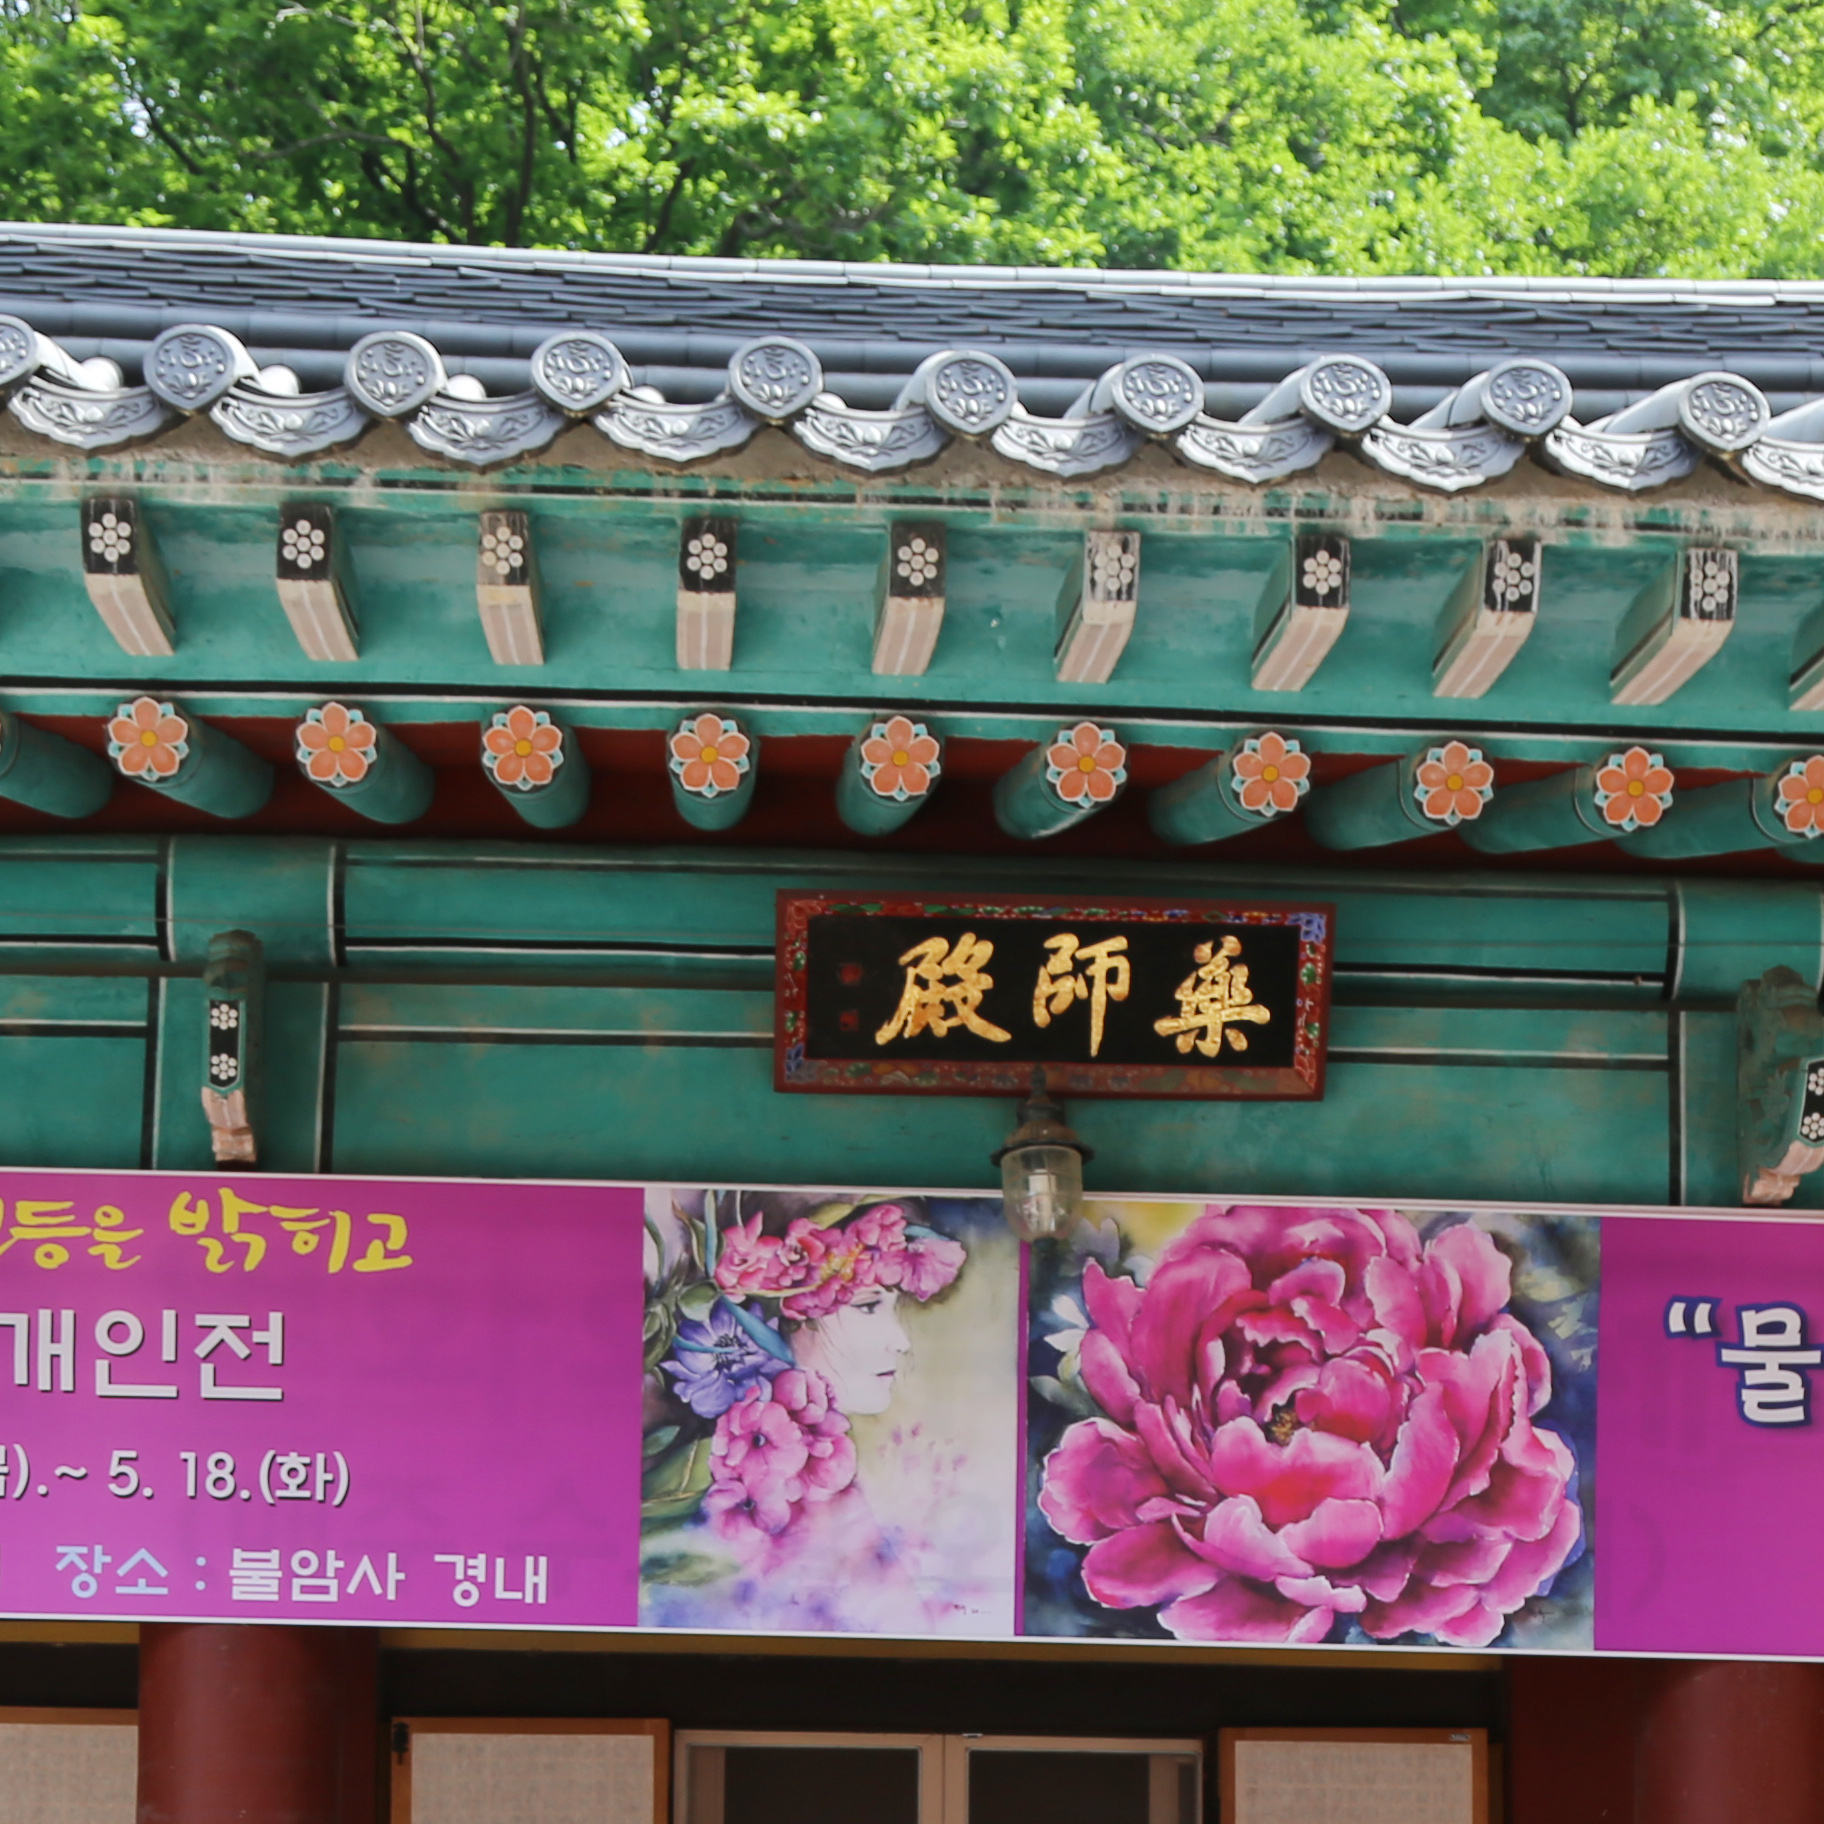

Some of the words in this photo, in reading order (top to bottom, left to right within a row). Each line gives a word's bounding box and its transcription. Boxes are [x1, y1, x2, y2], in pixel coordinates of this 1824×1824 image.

[168, 1186, 414, 1274] 밝히고
[107, 1449, 156, 1500] 5.
[179, 1450, 352, 1507] 18.(화)
[54, 1543, 170, 1598] 장소
[228, 1549, 406, 1603] 불암사
[433, 1552, 550, 1608] 경내
